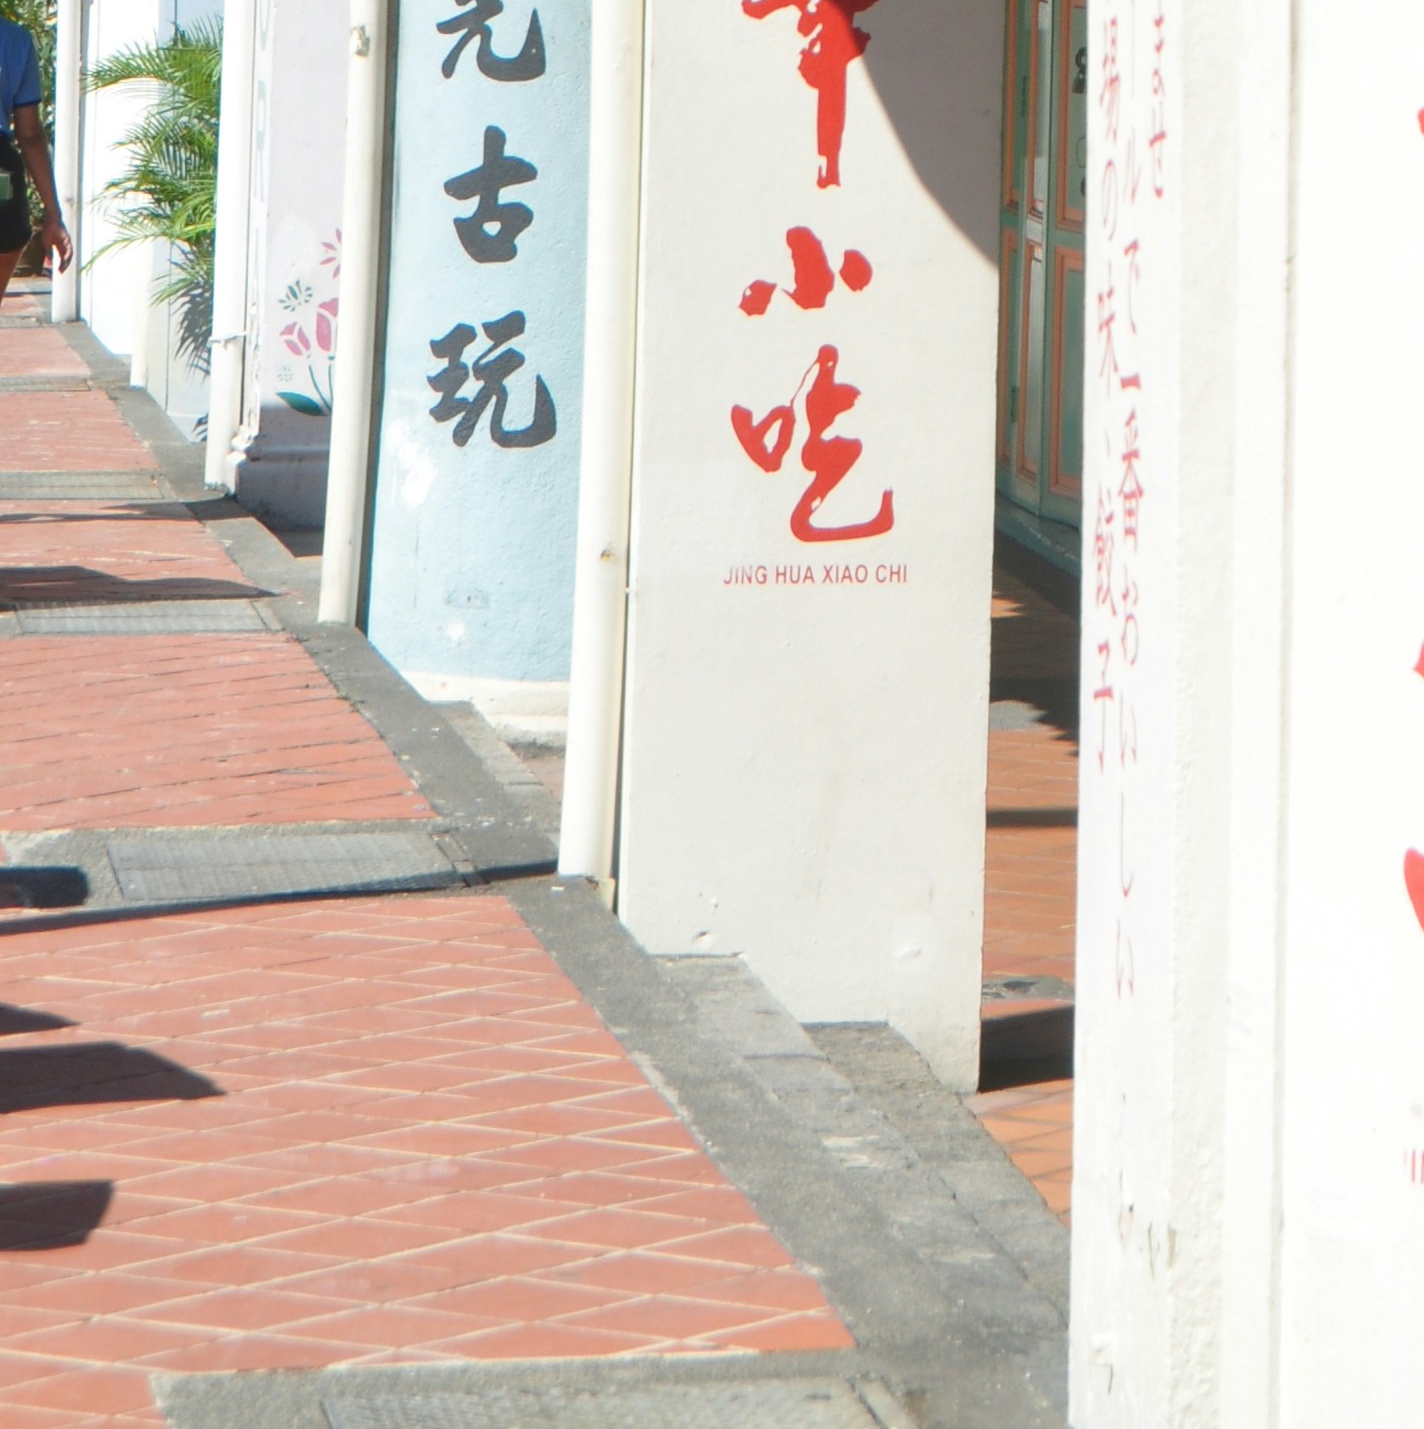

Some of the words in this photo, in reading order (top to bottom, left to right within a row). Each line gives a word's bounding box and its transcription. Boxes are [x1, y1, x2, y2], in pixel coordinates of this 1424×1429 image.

[775, 563, 816, 585] HUA
[822, 563, 869, 585] XIAO
[874, 563, 908, 584] CHI
